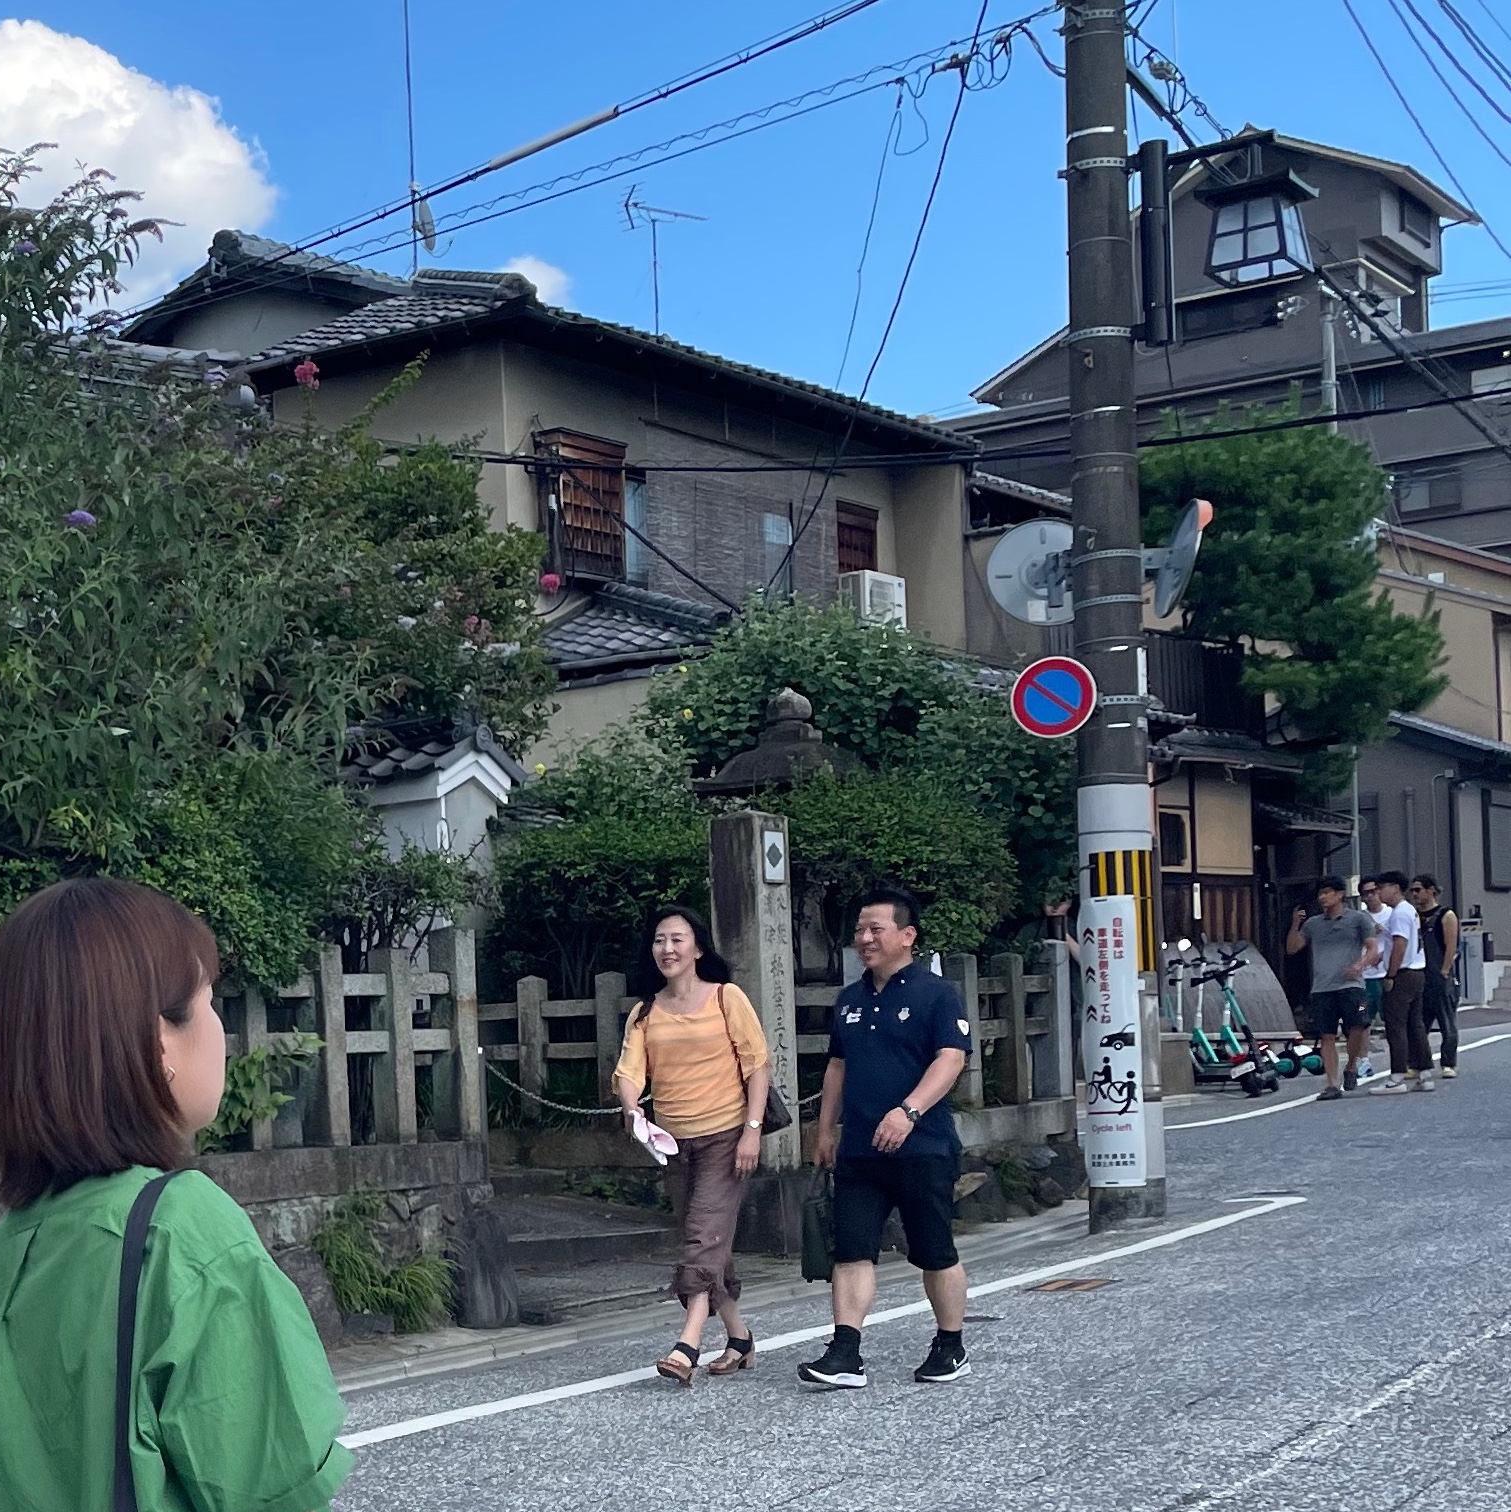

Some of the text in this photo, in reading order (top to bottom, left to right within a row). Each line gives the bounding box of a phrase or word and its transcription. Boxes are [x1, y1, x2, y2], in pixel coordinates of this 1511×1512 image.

[1112, 917, 1125, 960] 自転車は
[1097, 927, 1112, 1024] 車道左側を走ってね
[1091, 1123, 1133, 1134] Cycle left
